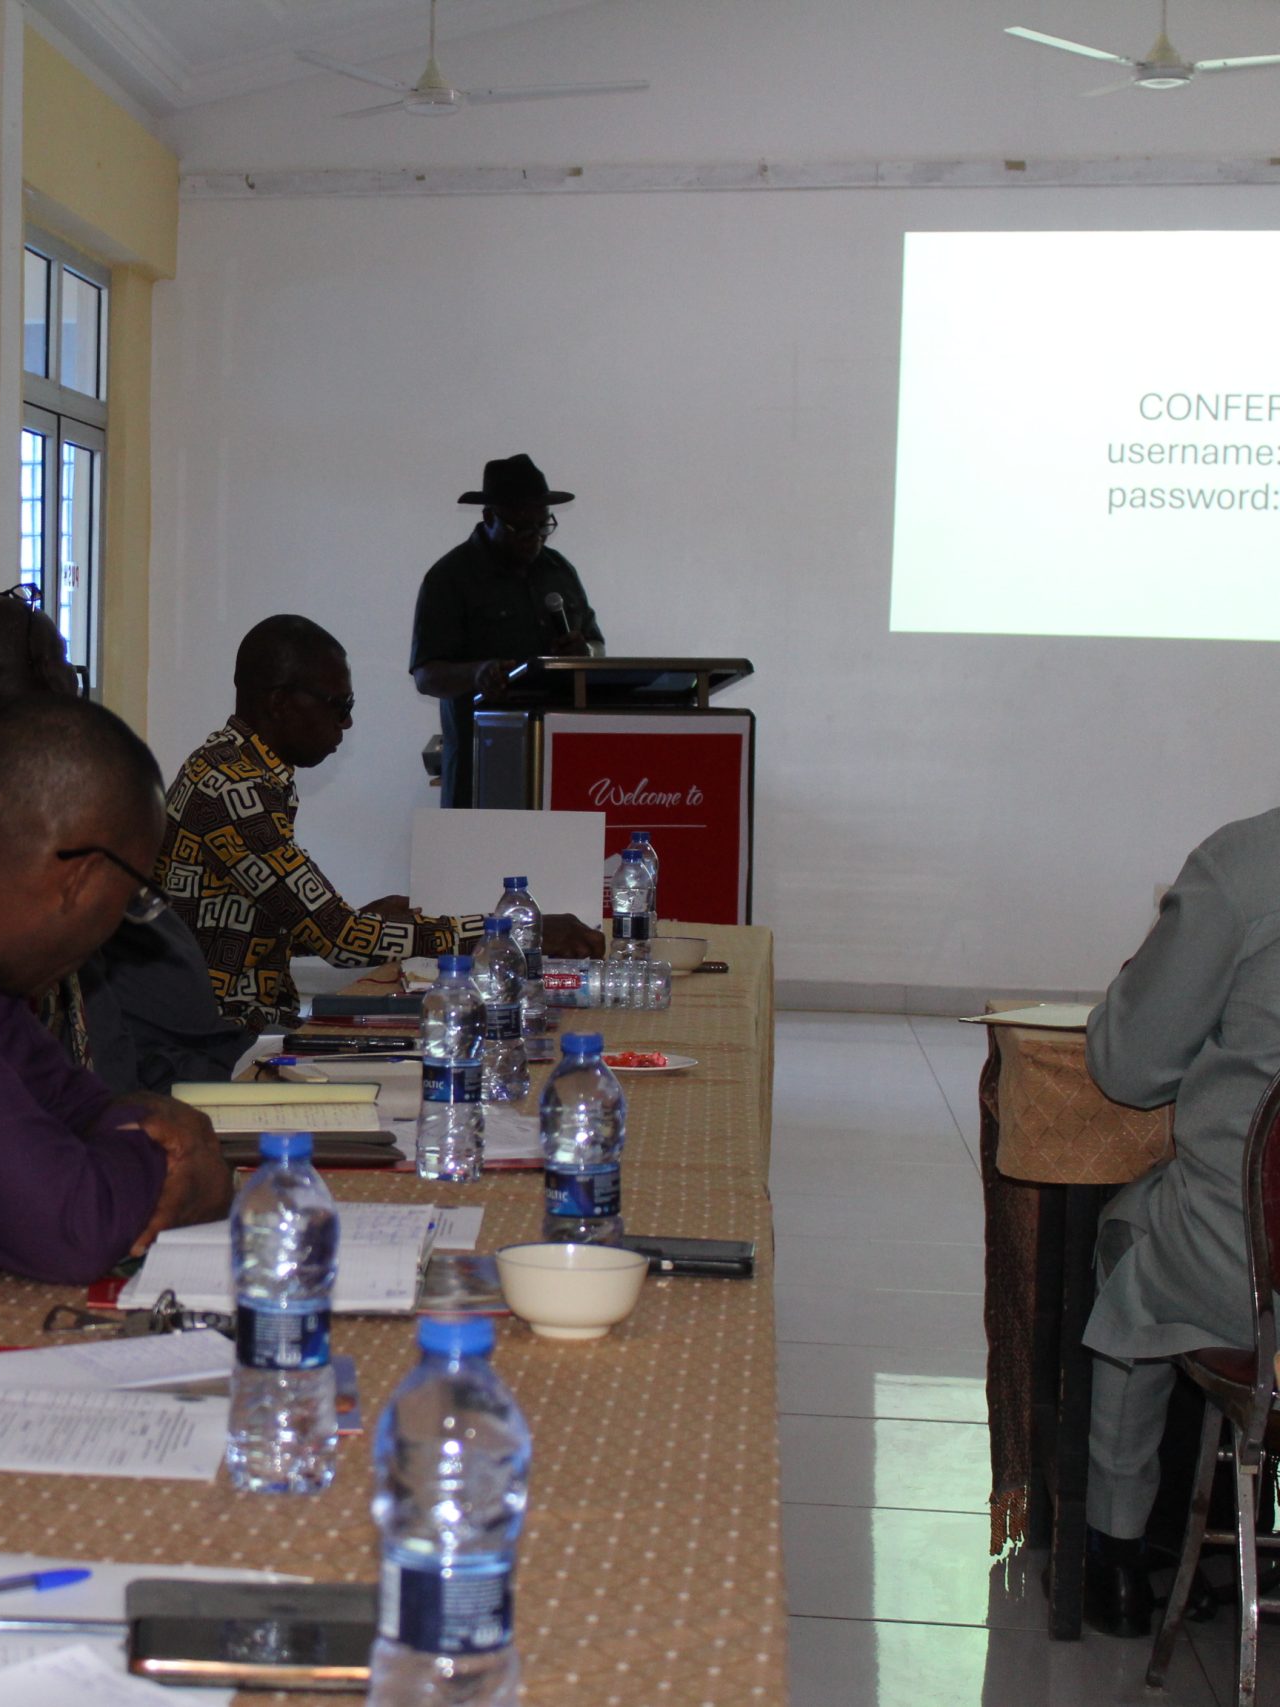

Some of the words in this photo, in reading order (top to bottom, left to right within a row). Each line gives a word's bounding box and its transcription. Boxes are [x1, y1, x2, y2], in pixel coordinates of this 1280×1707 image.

[1108, 483, 1279, 515] password:
[588, 778, 681, 808] Welcome
[686, 785, 704, 806] to
[423, 1079, 444, 1090] OLTIC
[545, 1188, 568, 1202] OLTIC
